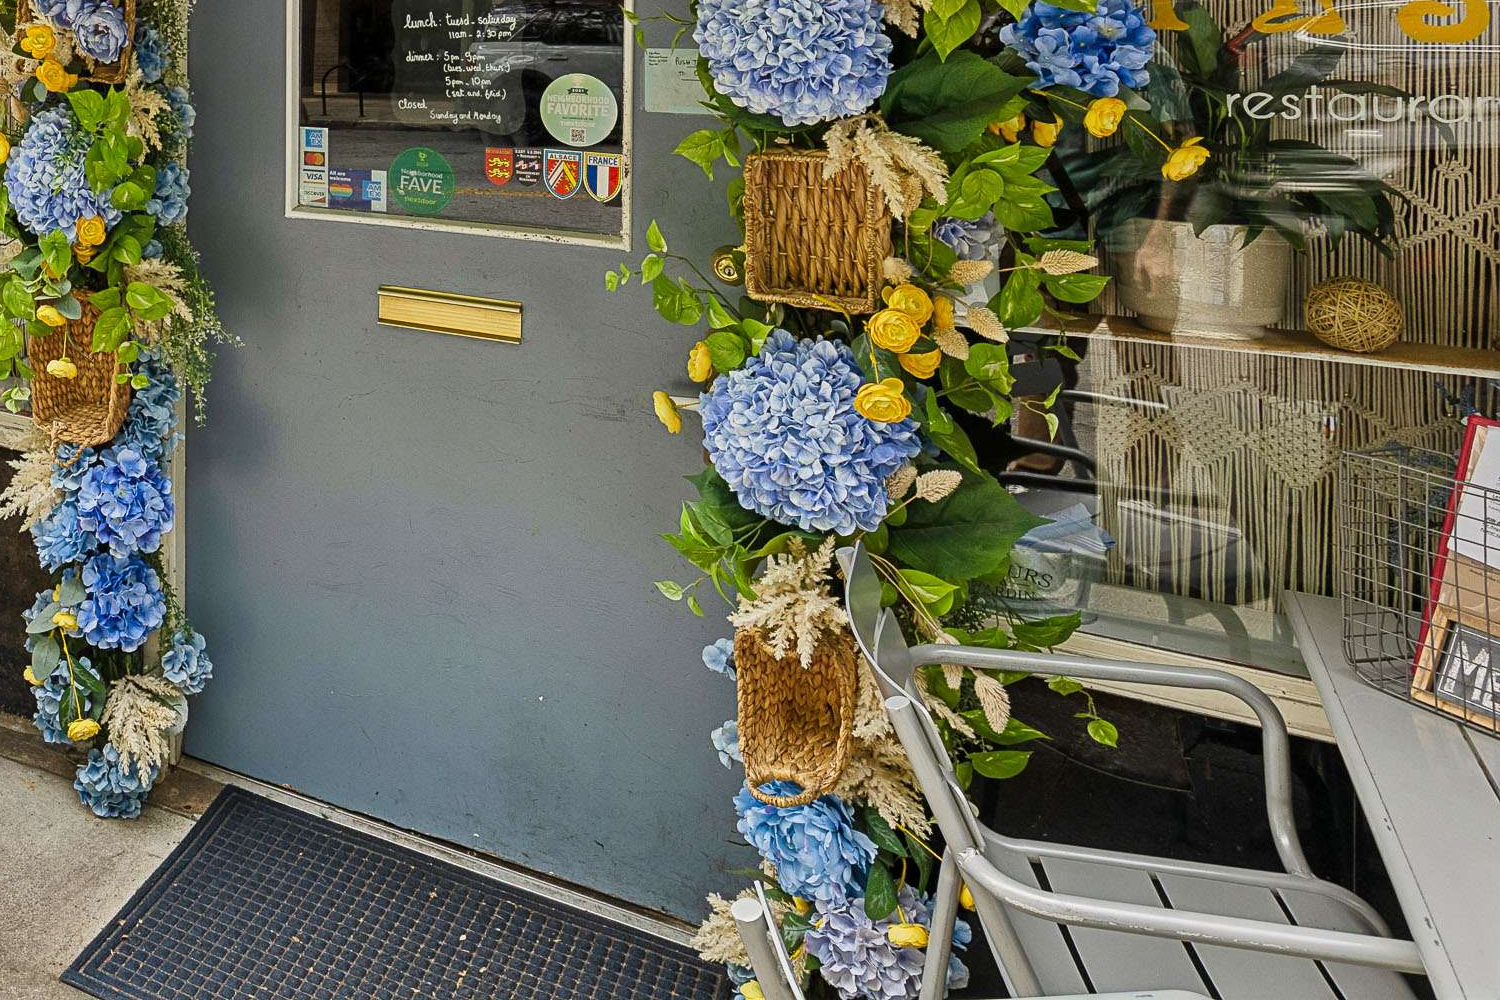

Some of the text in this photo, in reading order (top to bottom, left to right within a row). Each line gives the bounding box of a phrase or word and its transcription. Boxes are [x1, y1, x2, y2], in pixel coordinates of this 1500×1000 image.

[477, 12, 517, 31] saturday
[398, 98, 428, 109] Closed
[547, 102, 610, 118] FAVORITE
[430, 110, 457, 124] Sunday
[473, 111, 501, 124] Monday
[549, 153, 578, 161] ALSACE
[588, 156, 618, 166] FRANCE
[306, 173, 323, 181] VISA
[400, 175, 443, 195] FAVE
